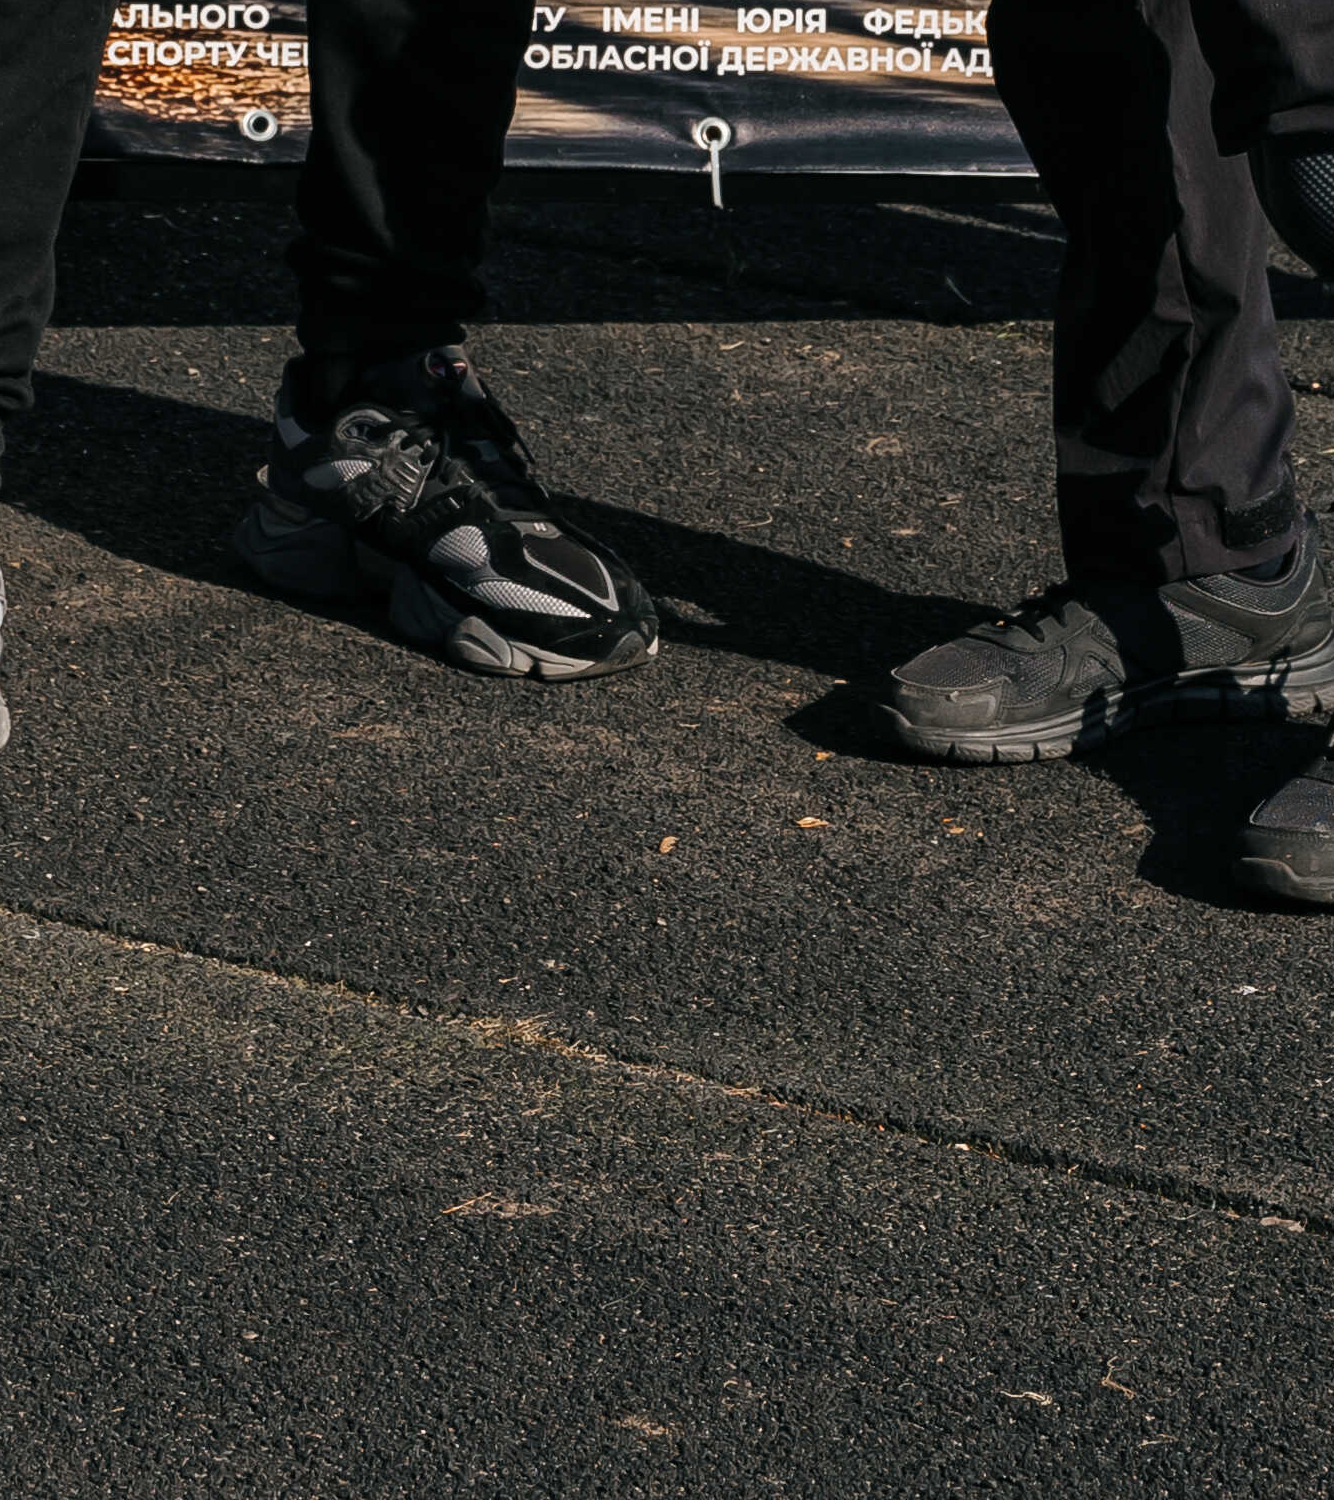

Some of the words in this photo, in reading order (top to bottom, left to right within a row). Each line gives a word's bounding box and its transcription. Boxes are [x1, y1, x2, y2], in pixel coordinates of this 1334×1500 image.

[602, 6, 700, 33] ІМЕНІ
[737, 7, 827, 34] ЮРІЯ
[107, 40, 248, 67] СПОРТУ
[523, 39, 712, 71] ОБЛАСНОЇ
[716, 41, 935, 76] ДЕРЖАВНОЇ
